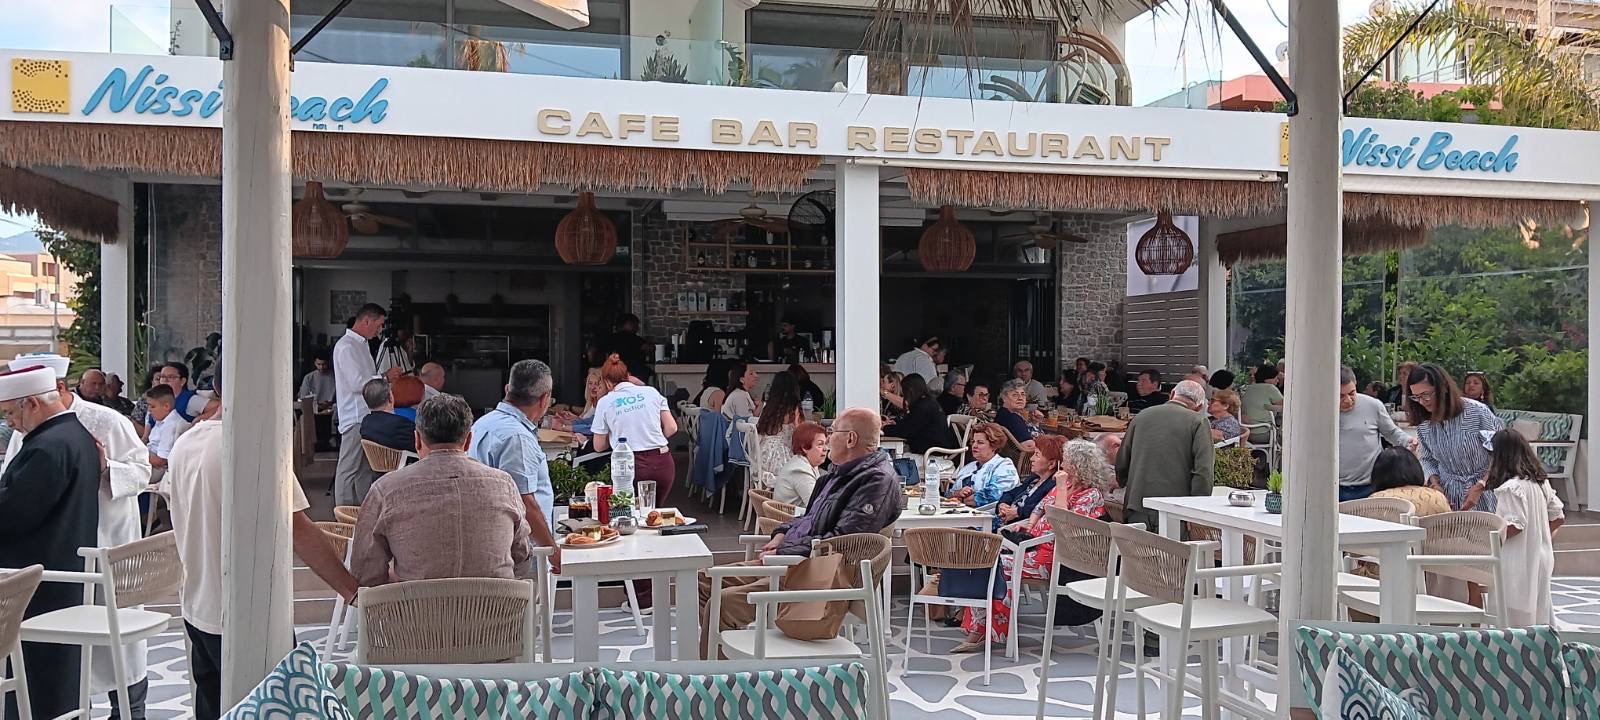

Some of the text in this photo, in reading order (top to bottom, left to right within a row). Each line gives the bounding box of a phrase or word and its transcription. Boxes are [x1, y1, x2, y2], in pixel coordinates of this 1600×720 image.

[537, 108, 1171, 161] CAFE BAR RESTAURANT
[1417, 131, 1519, 173] Beach
